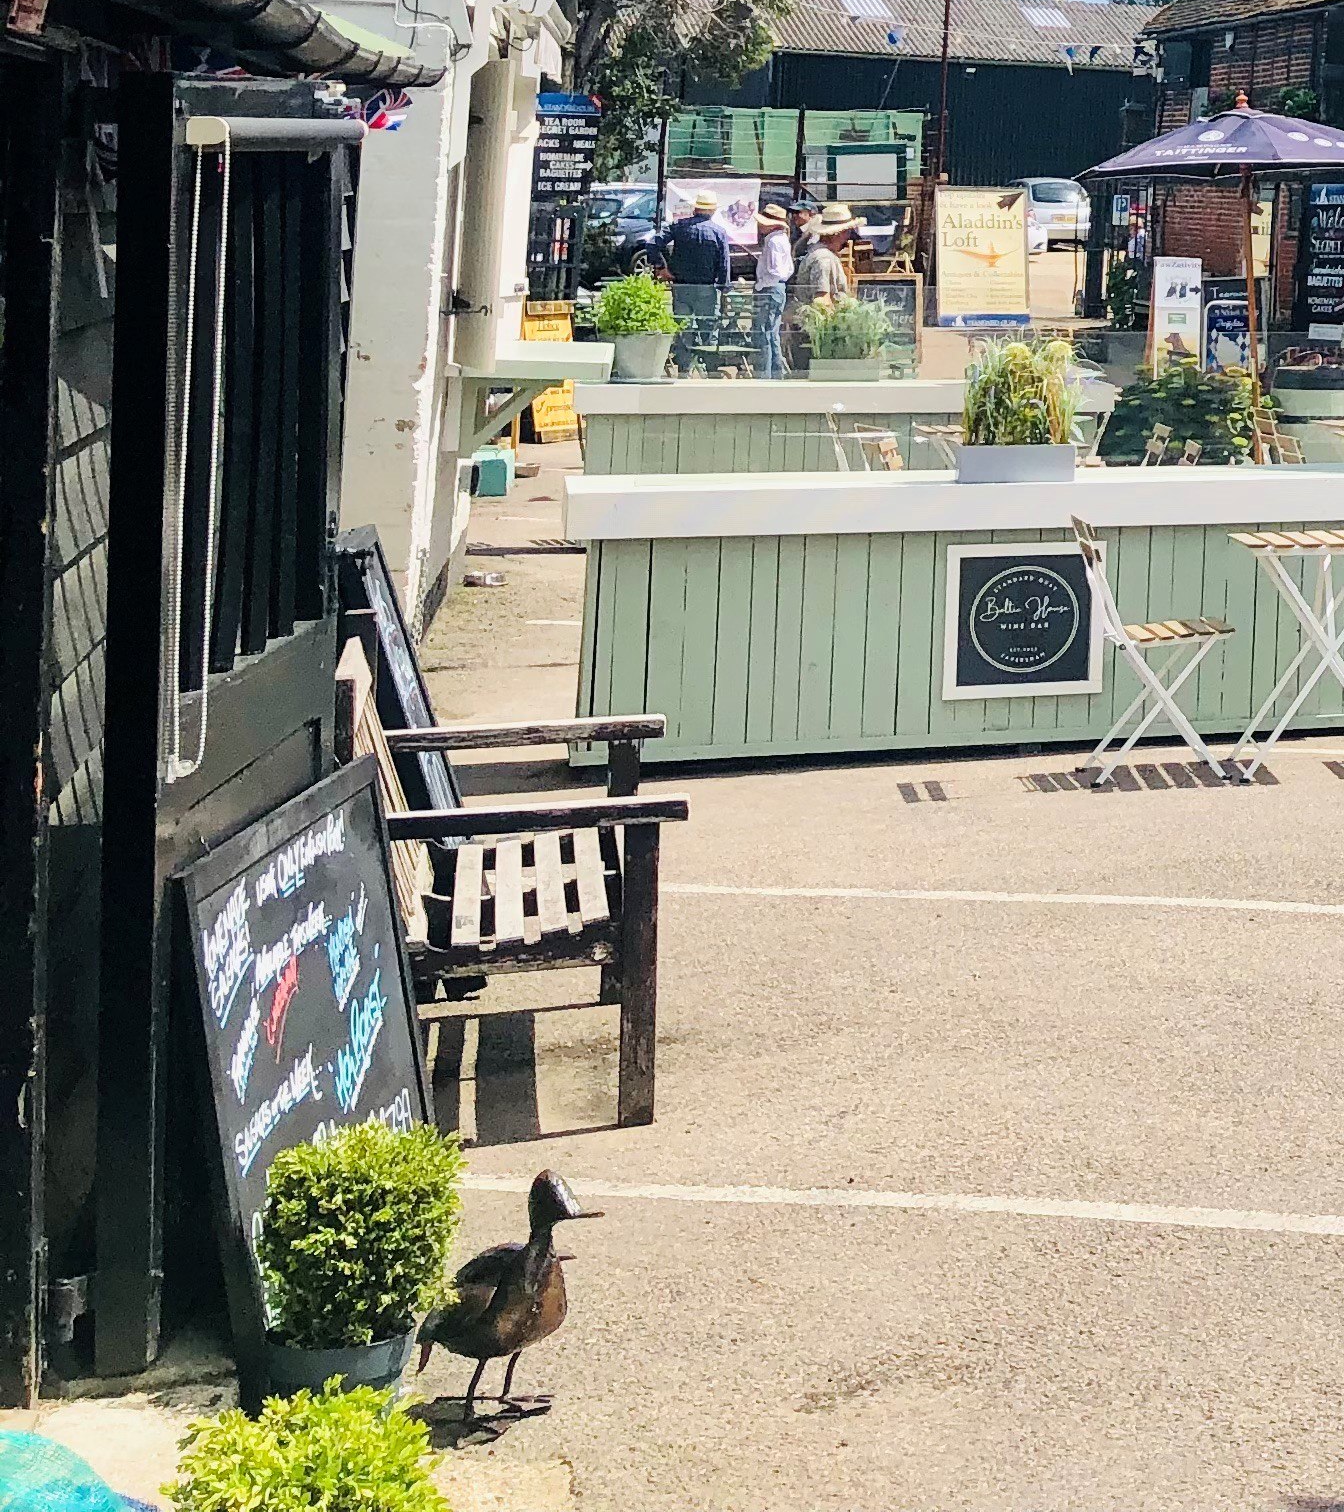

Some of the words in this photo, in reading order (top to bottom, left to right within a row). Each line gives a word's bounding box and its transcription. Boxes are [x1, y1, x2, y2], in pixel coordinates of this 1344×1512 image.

[544, 117, 560, 126] TEA
[562, 118, 586, 127] ROOM
[1154, 147, 1248, 157] TAITTINGER
[538, 182, 552, 190] ICE
[941, 213, 1023, 230] Aladdin's
[941, 231, 979, 248] Loft
[1310, 233, 1341, 253] SECRET
[980, 596, 1022, 622] Baltic
[1025, 596, 1070, 620] House
